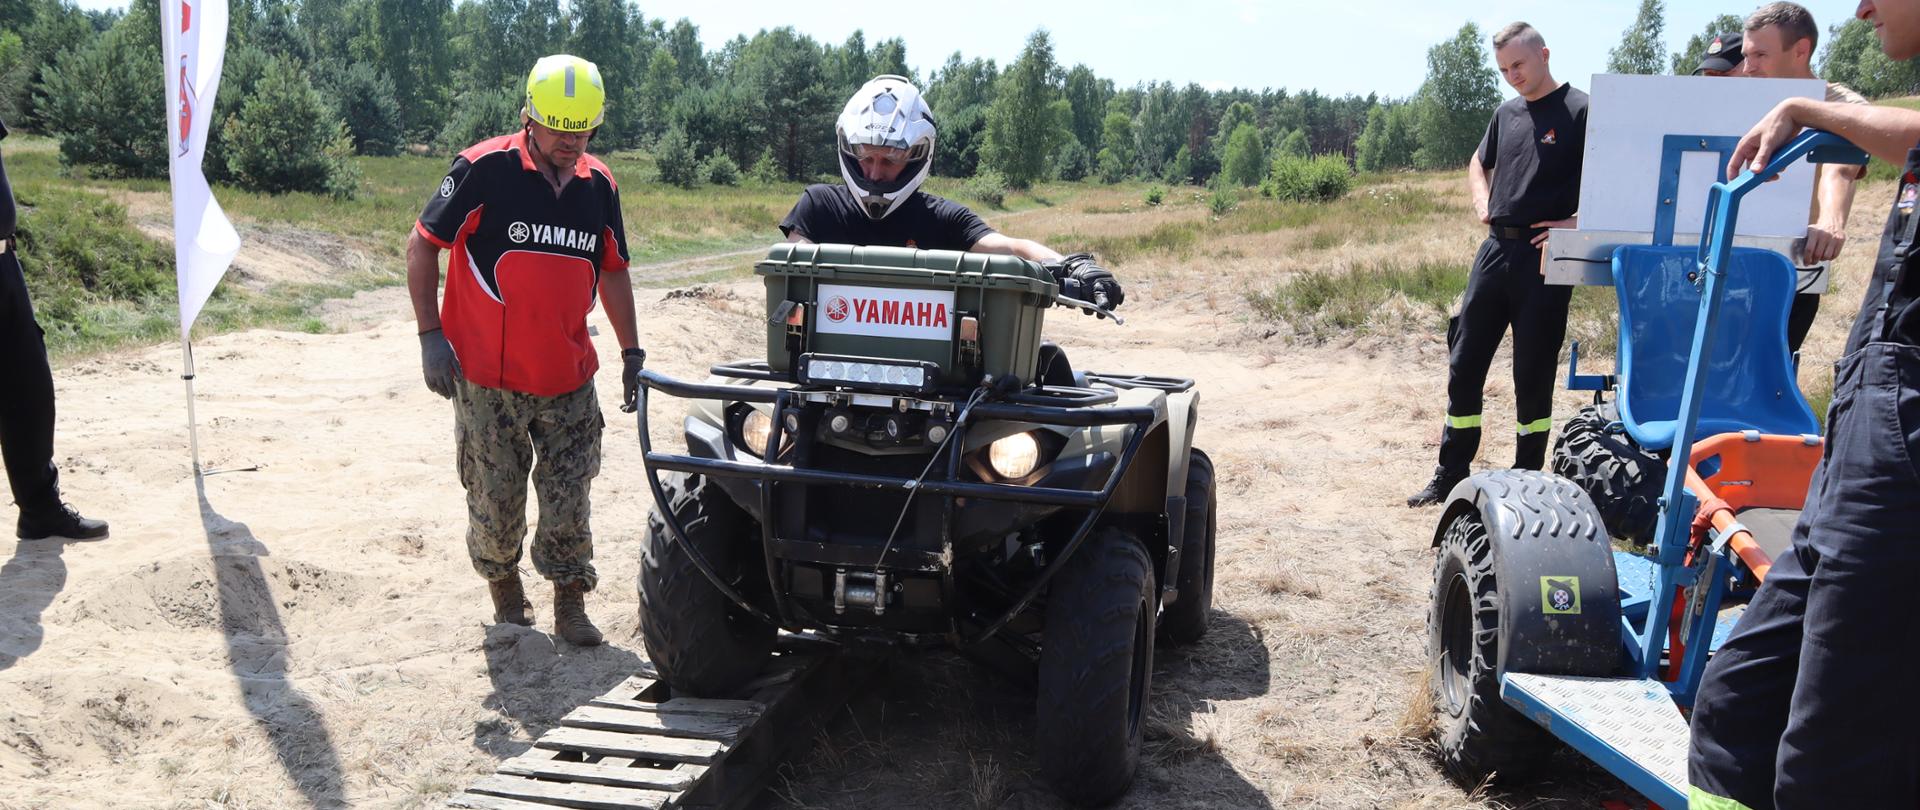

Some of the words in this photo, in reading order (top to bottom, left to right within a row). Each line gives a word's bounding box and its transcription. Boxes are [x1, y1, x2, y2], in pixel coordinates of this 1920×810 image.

[547, 115, 560, 127] Mr
[563, 117, 588, 130] Quad
[531, 224, 597, 252] YAMAHA
[853, 298, 947, 328] YAMAHA
